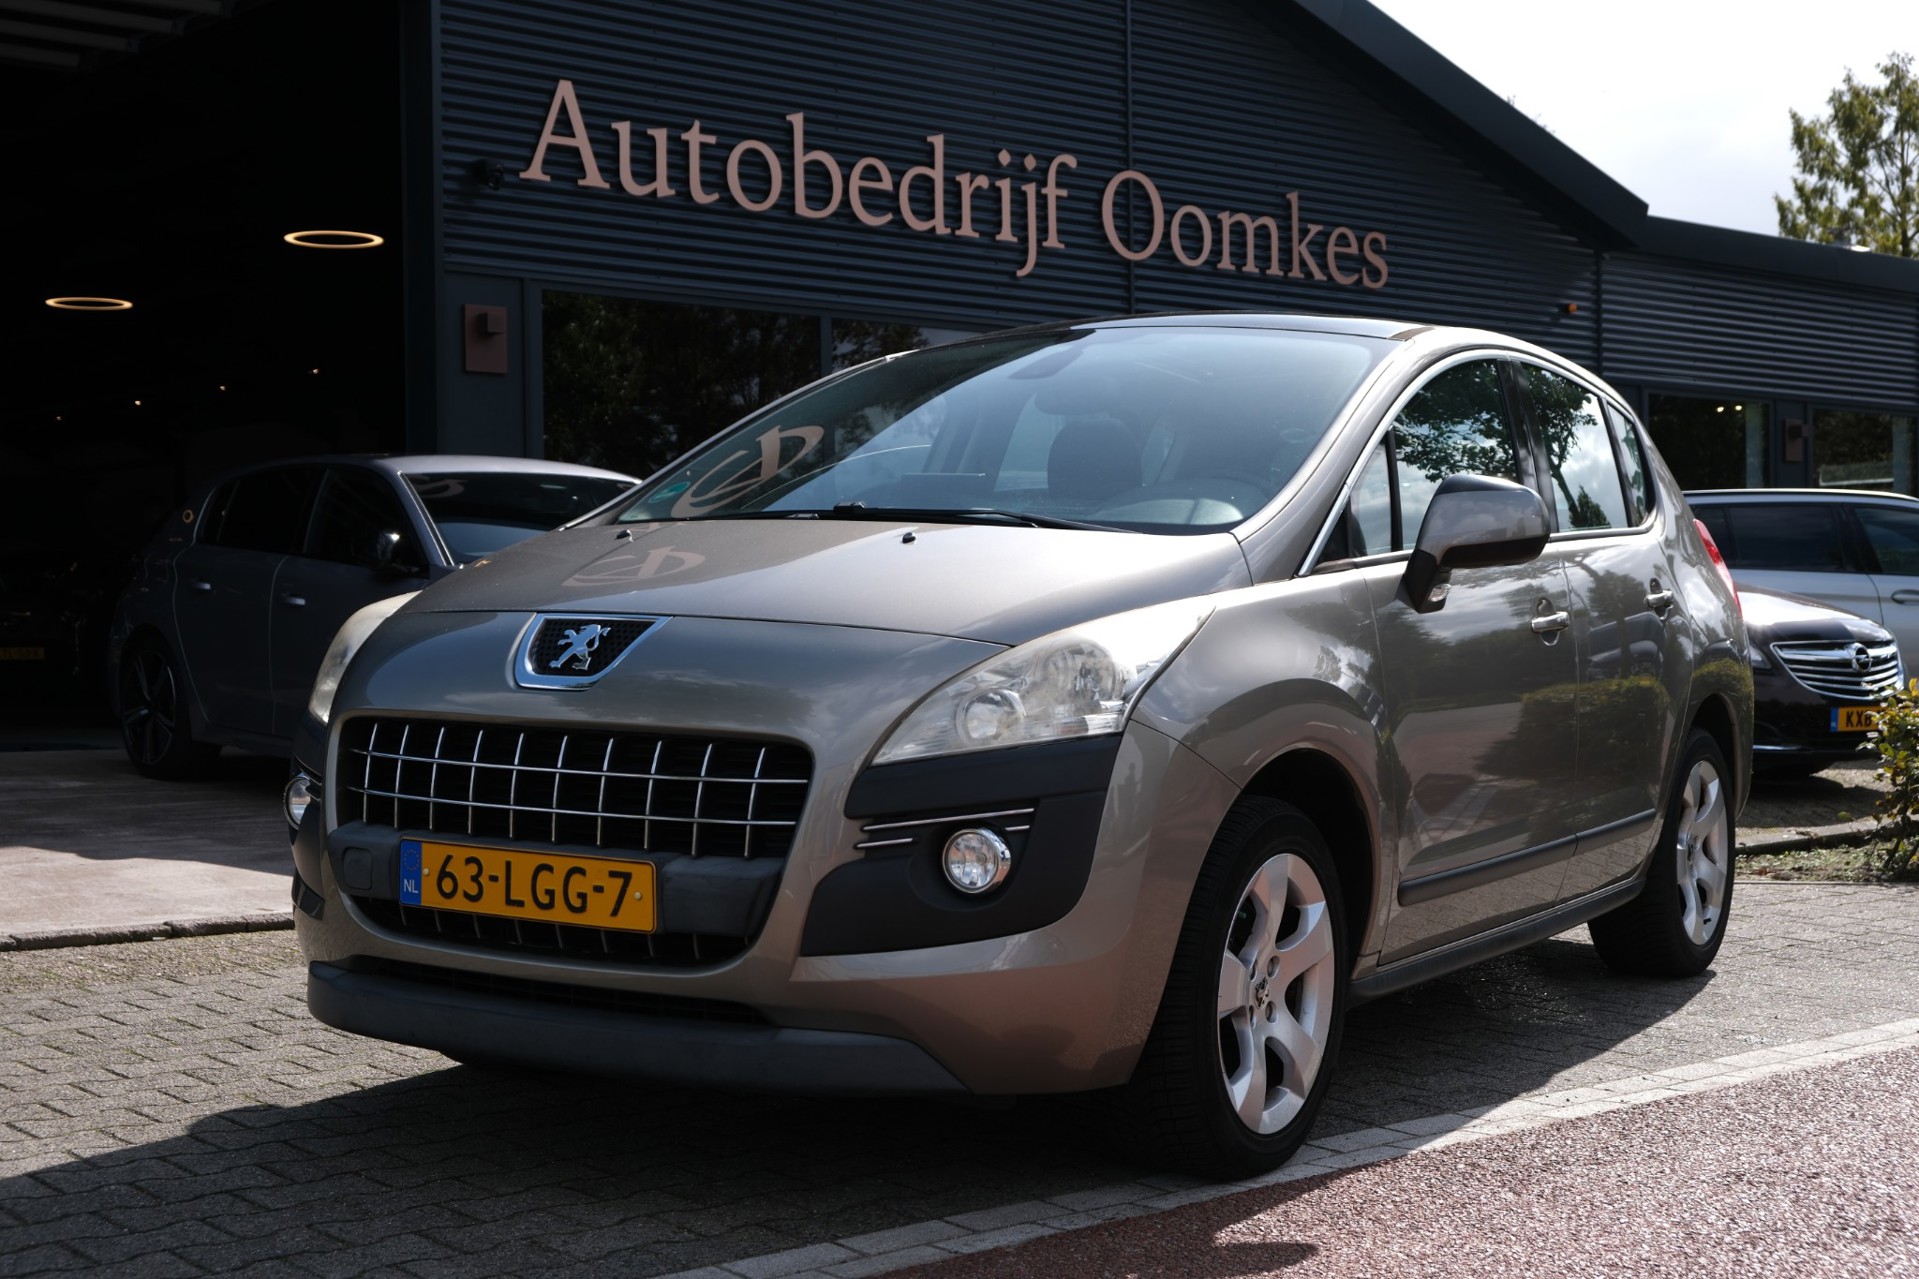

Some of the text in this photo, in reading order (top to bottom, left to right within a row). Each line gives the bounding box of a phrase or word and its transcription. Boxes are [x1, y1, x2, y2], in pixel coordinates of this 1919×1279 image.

[519, 79, 1389, 289] Autobedrijf Oomkes
[403, 878, 418, 894] NL
[436, 854, 633, 917] 63-LGG-7
